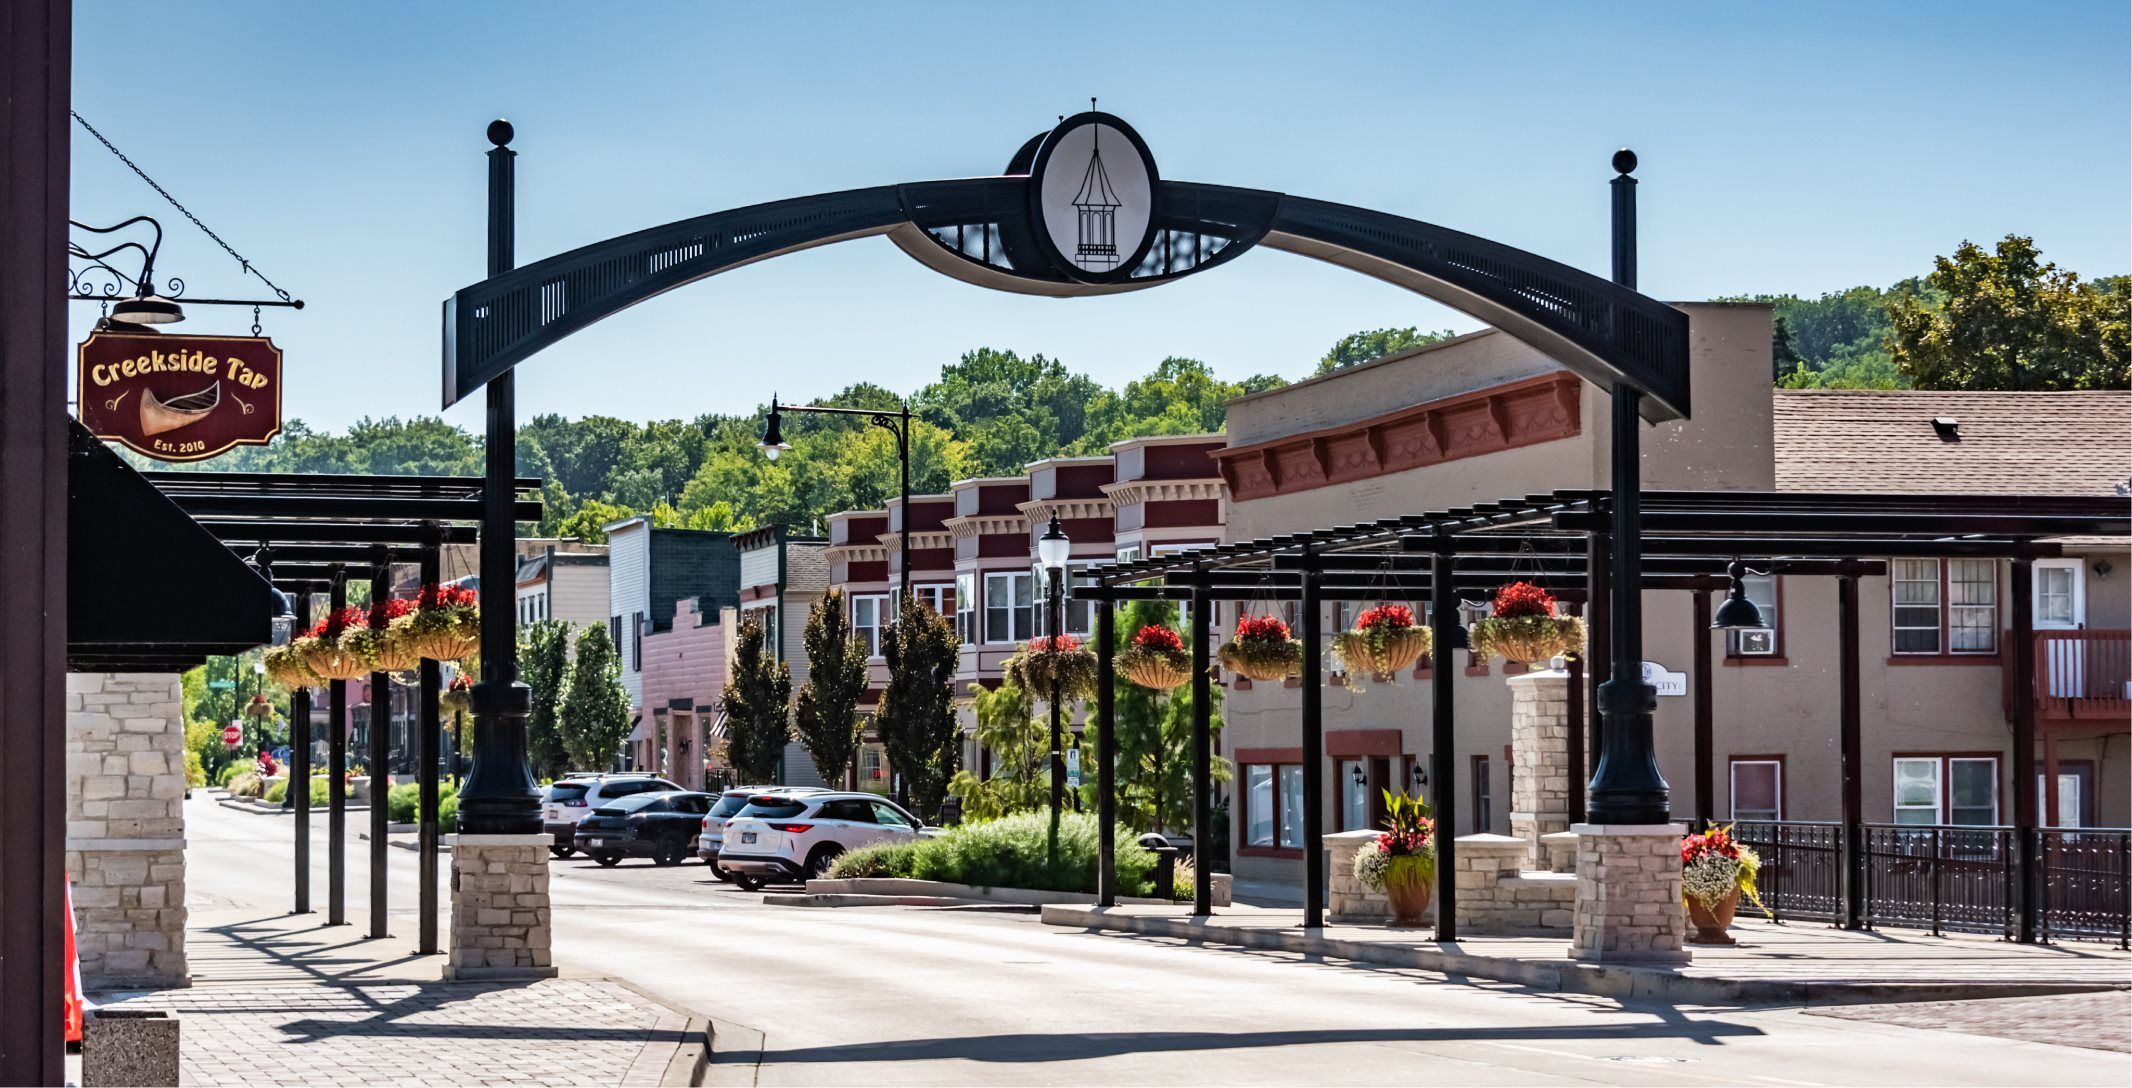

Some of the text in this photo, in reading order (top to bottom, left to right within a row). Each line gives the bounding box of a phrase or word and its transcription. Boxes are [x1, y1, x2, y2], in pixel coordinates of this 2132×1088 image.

[92, 349, 268, 390] Creekside Tap
[154, 439, 205, 453] Est. 2010
[223, 731, 241, 740] STOP
